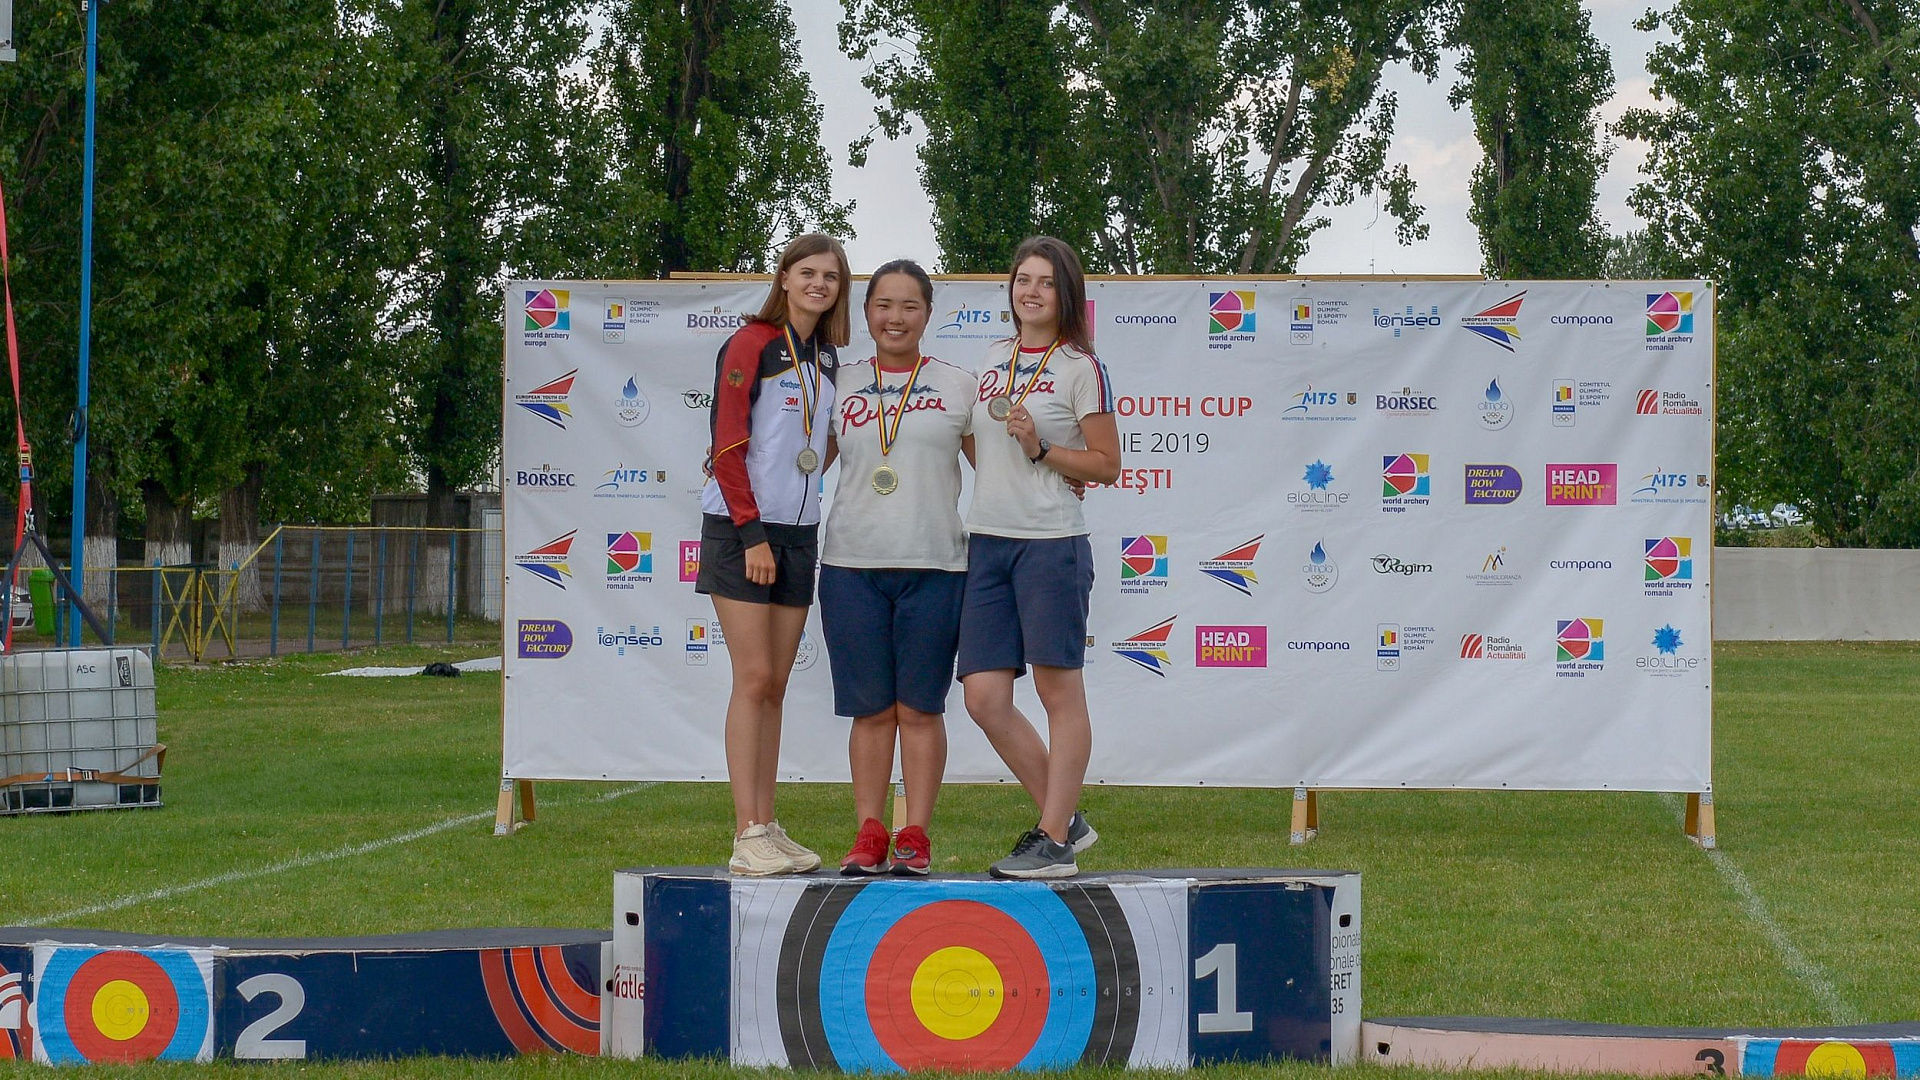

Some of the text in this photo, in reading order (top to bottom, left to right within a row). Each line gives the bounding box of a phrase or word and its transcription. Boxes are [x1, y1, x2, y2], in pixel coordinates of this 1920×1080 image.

[956, 310, 991, 323] MTS
[1115, 315, 1177, 326] cumpana
[1550, 315, 1613, 327] cumpana
[524, 331, 570, 341] world archery
[1229, 334, 1255, 343] archery
[1667, 336, 1693, 344] archery
[979, 370, 1055, 401] Rusia
[785, 397, 799, 406] 3M
[1302, 392, 1337, 405] MTS
[1662, 392, 1686, 400] Radio
[1114, 396, 1252, 417] OUTH CUP
[1376, 394, 1437, 410] BORSEC
[1662, 399, 1698, 408] România
[1150, 432, 1210, 453] 2019
[613, 470, 648, 483] MTS
[1467, 469, 1504, 477] DREAM
[1551, 470, 1600, 485] HEAD
[517, 471, 575, 487] BORSEC
[1470, 479, 1496, 488] BOW
[1651, 474, 1687, 487] MTS
[1473, 489, 1519, 499] FACTORY
[1551, 485, 1605, 500] PRINT
[1403, 498, 1430, 506] archery
[1382, 506, 1406, 514] europe
[1550, 559, 1612, 572] cumpana
[627, 575, 653, 583] archery
[1142, 579, 1168, 588] archery
[1644, 581, 1692, 590] world archery
[521, 623, 556, 632] DREAM
[523, 634, 547, 642] BOW
[1201, 632, 1250, 647] HEAD
[1487, 636, 1510, 644] Radio
[526, 644, 570, 653] FACTORY
[1287, 641, 1350, 652] cumpana
[1201, 646, 1255, 662] PRINT
[1556, 662, 1604, 671] world archery
[1195, 943, 1253, 1034] 1
[234, 973, 306, 1059] 2
[1695, 1048, 1726, 1076] 3
